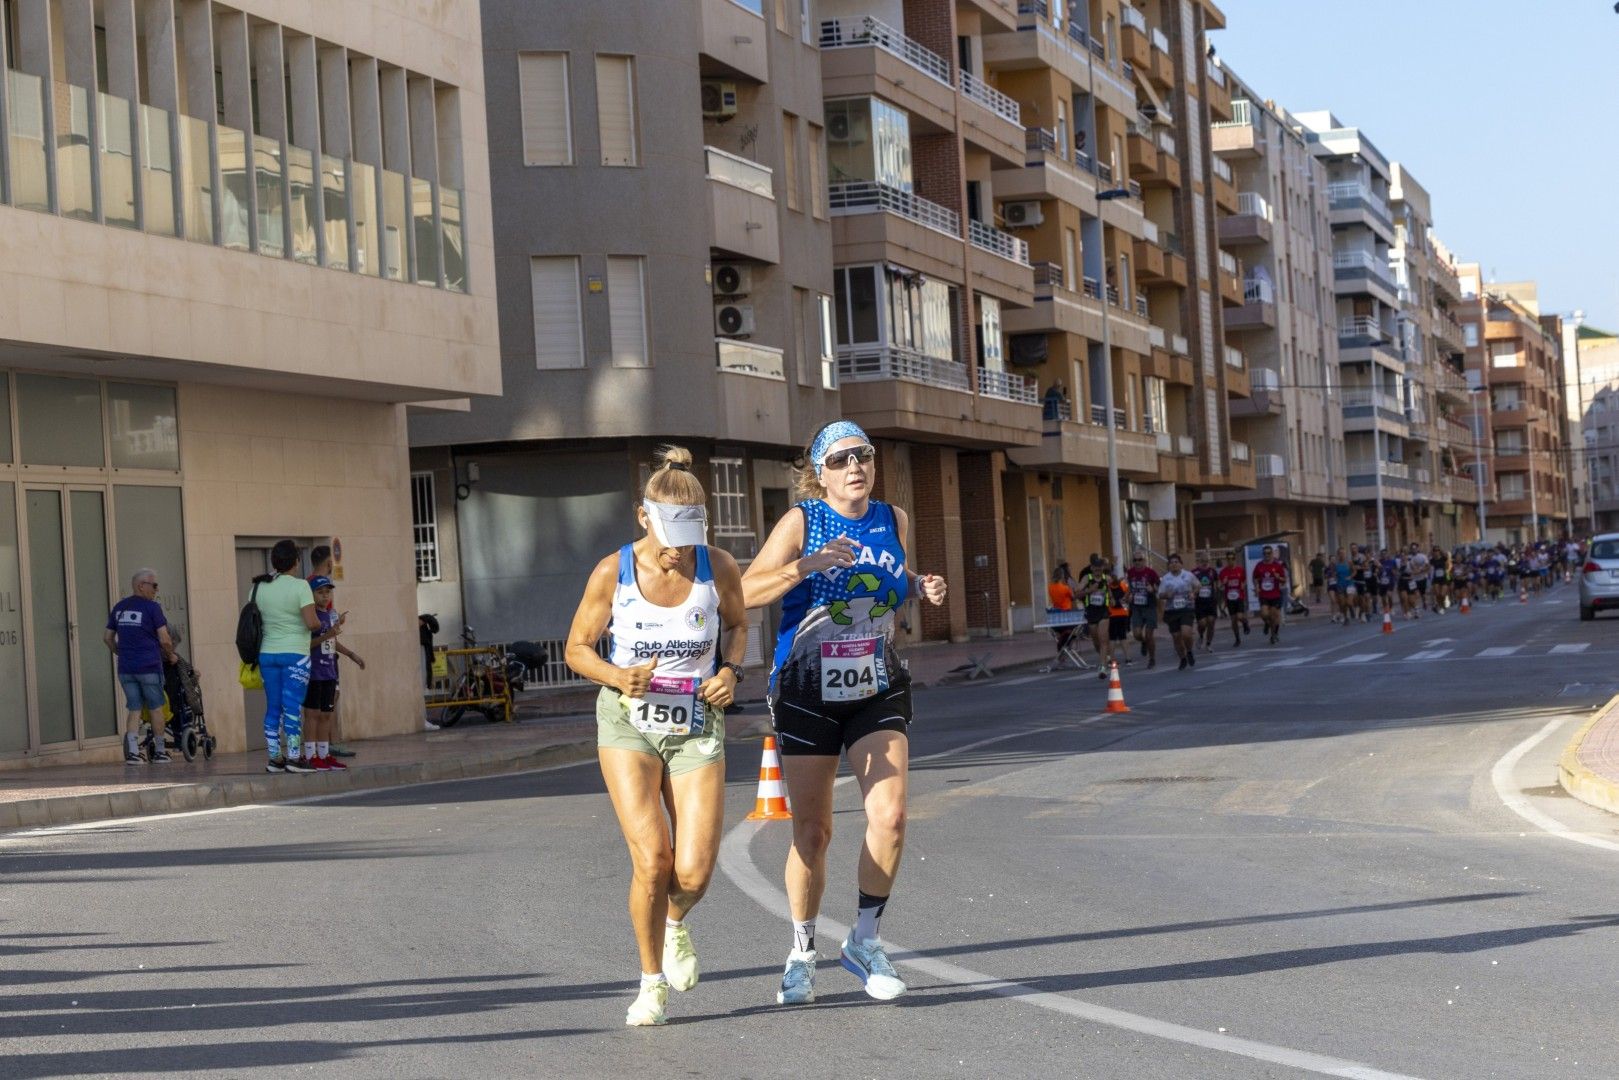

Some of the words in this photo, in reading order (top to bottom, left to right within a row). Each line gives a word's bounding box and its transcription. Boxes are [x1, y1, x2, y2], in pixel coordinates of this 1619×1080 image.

[634, 640, 662, 650] Club
[666, 639, 713, 650] Atletismo
[830, 644, 839, 656] X
[875, 658, 885, 676] KM
[826, 666, 874, 688] 204
[637, 703, 688, 724] 150
[694, 701, 705, 719] KM
[693, 721, 703, 729] 7
